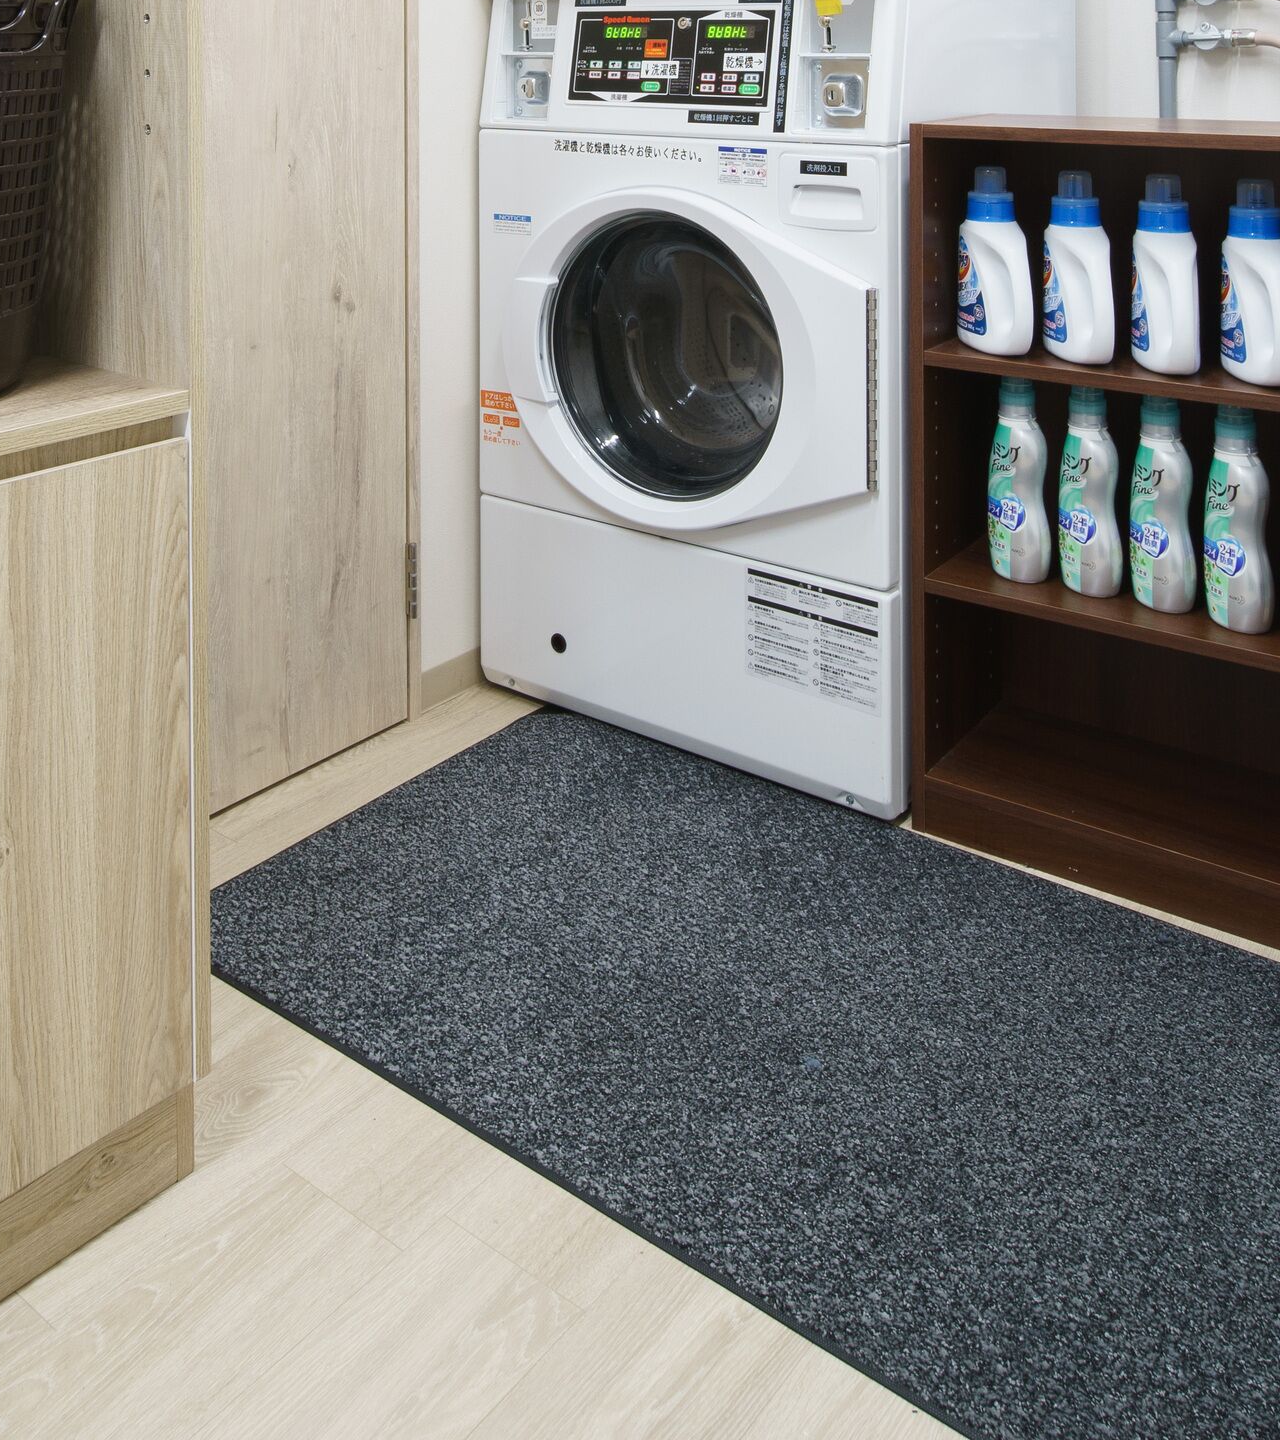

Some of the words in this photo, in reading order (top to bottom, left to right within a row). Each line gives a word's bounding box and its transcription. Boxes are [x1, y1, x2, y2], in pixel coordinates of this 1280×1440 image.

[603, 16, 626, 24] Speed
[725, 56, 754, 68] 乾燥機
[553, 139, 702, 163] 洗濯機と乾燥機は各々お使いください。
[806, 164, 840, 173] 洗剤投入口
[991, 458, 1011, 473] Fine
[1061, 469, 1081, 484] Fine
[1133, 481, 1153, 496] Fine
[1207, 496, 1229, 511] Fine
